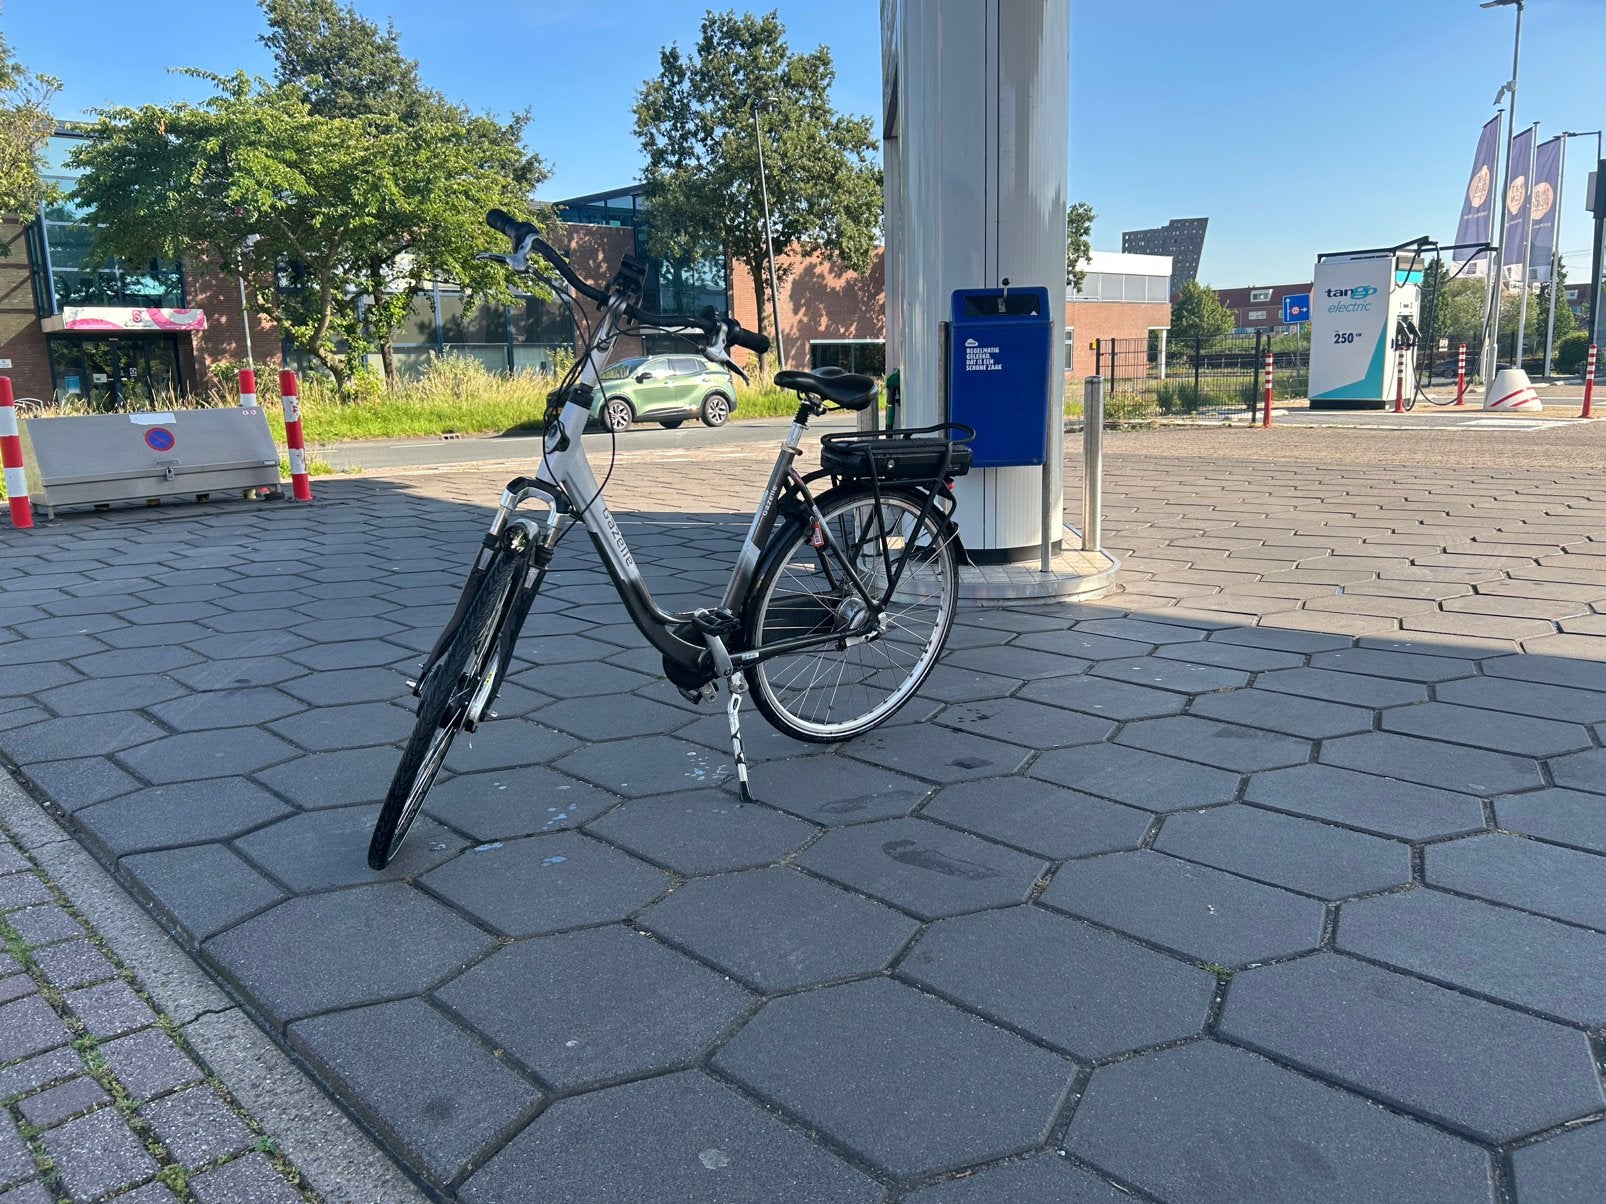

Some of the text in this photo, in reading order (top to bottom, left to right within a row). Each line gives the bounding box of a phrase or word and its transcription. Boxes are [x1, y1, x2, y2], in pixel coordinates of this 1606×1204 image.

[1325, 285, 1378, 300] tango
[1328, 301, 1372, 313] electric
[1334, 333, 1354, 344] 250
[602, 507, 633, 567] Gazelle
